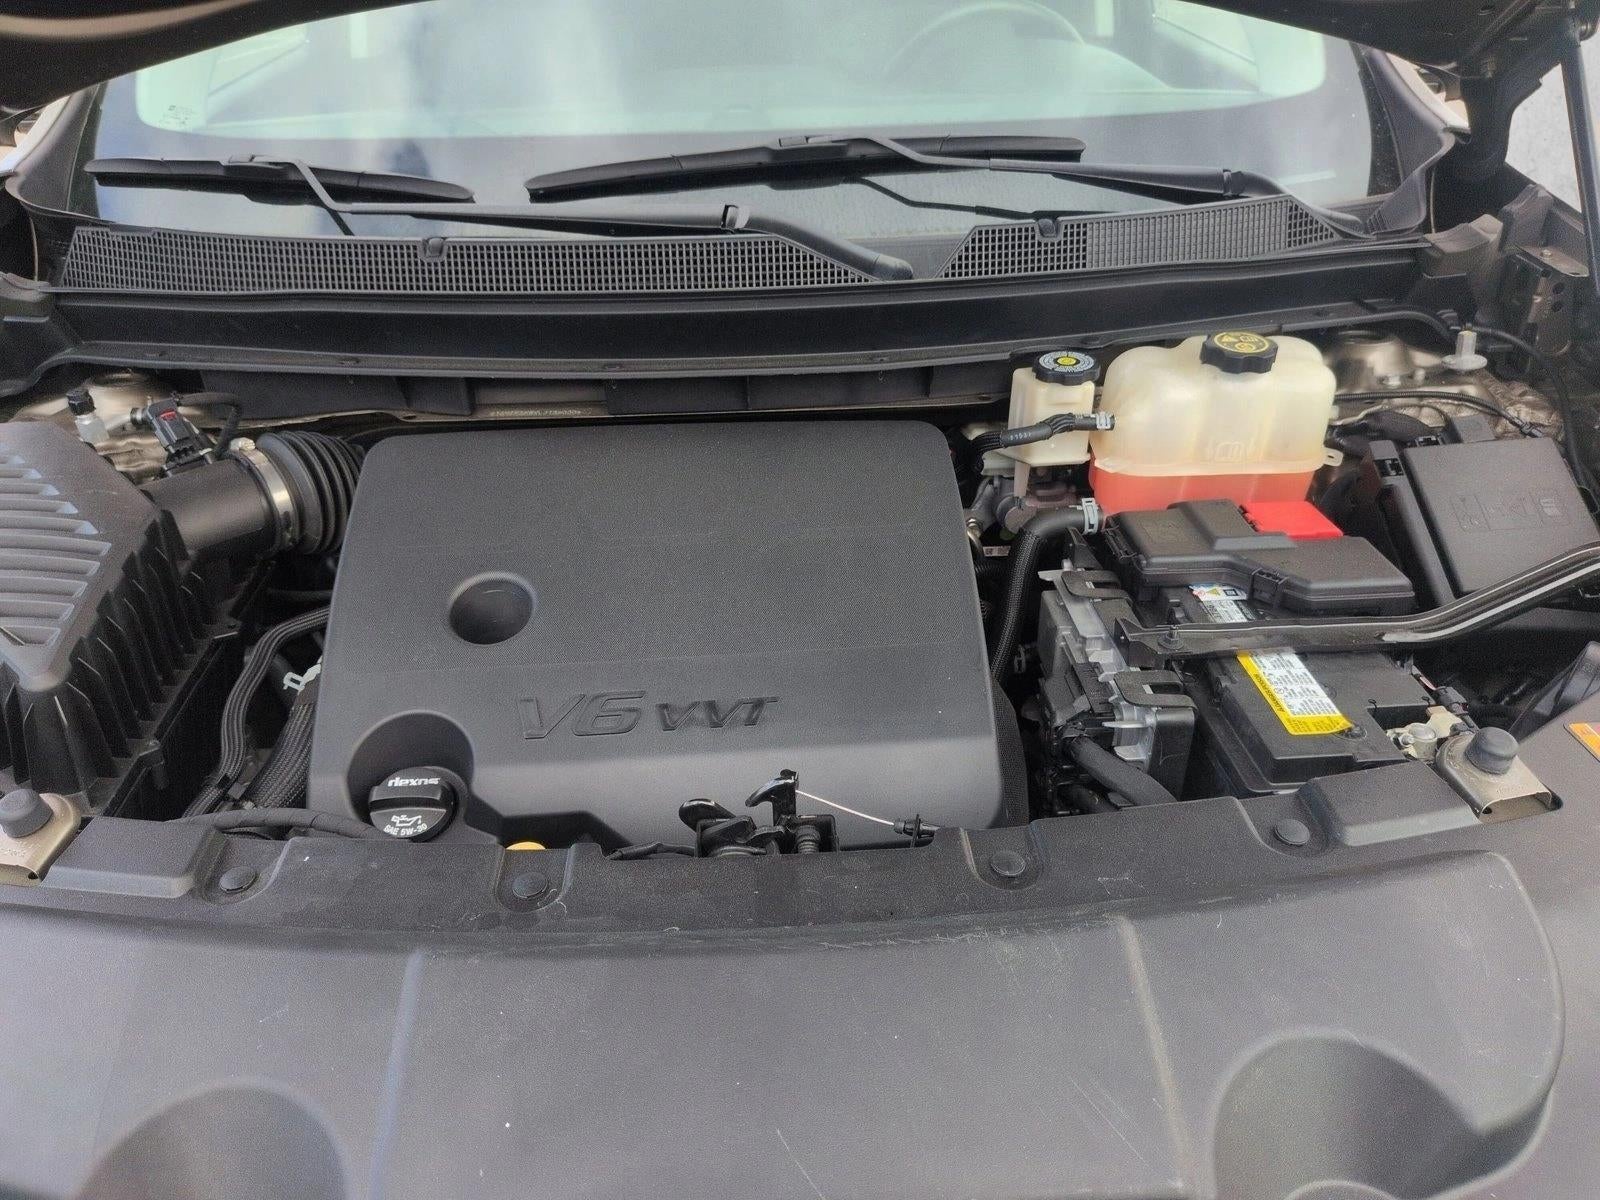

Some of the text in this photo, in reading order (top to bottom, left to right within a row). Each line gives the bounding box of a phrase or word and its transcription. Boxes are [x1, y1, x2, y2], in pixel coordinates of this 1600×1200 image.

[518, 690, 779, 740] V6 VVT
[383, 823, 428, 836] SAE 5W-30
